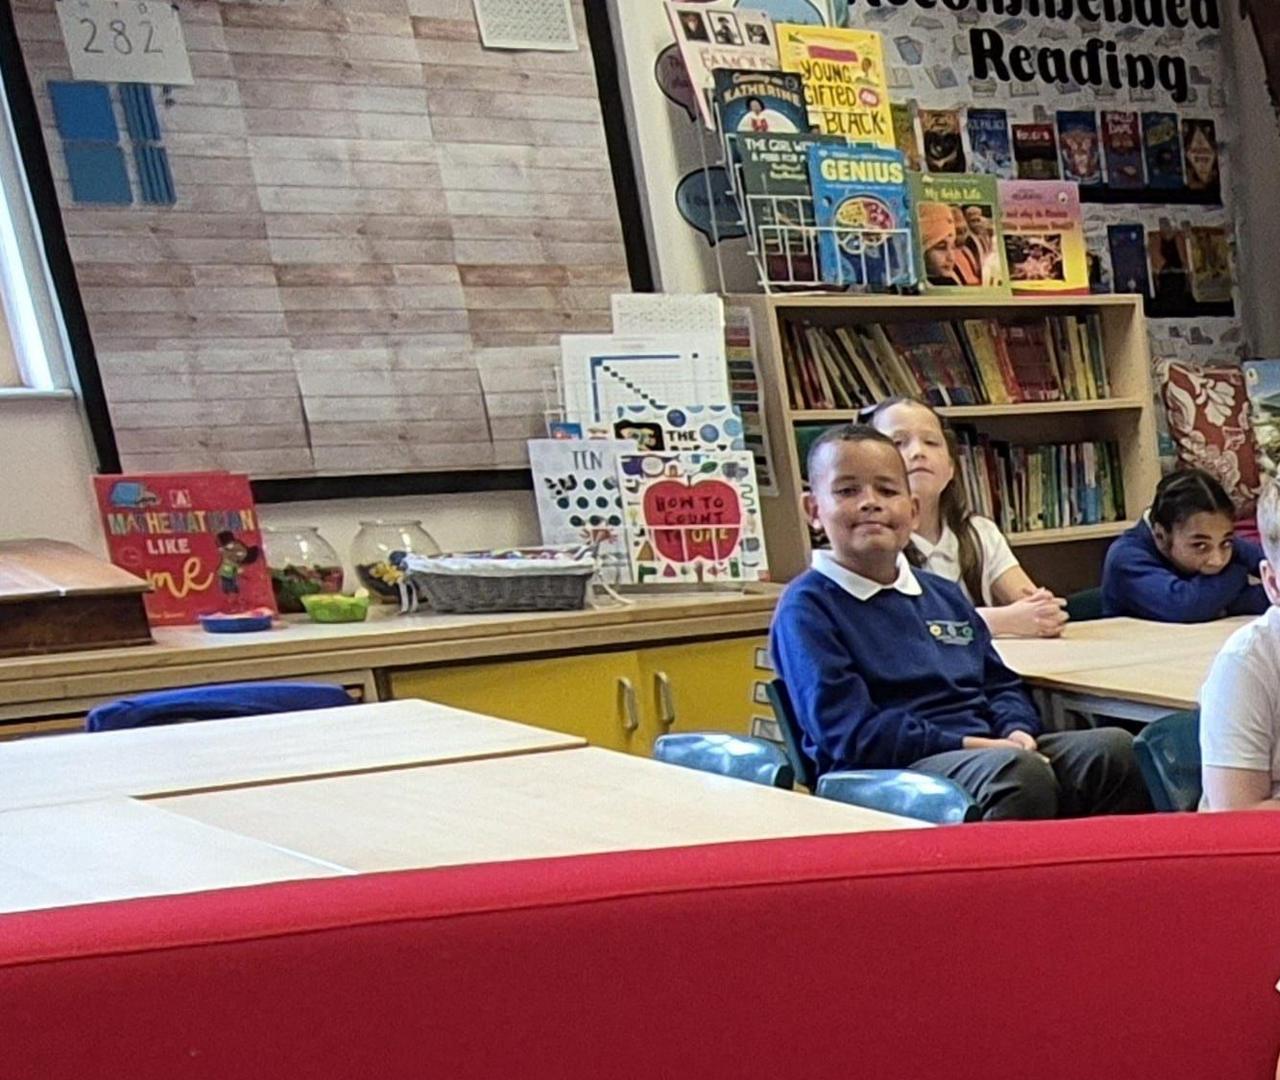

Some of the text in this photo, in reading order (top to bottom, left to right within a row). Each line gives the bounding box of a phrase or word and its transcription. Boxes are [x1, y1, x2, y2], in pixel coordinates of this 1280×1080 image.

[800, 59, 853, 84] YOUNG
[968, 27, 1189, 103] Reading
[822, 111, 885, 136] BLACK
[820, 158, 905, 184] GENIUS
[666, 430, 698, 442] THE
[572, 450, 603, 471] TEN
[655, 495, 725, 513] HOW TO
[107, 509, 255, 536] MATHEMATICIAN
[663, 511, 726, 526] COUNT
[146, 537, 191, 555] LIKE
[144, 556, 215, 599] me
